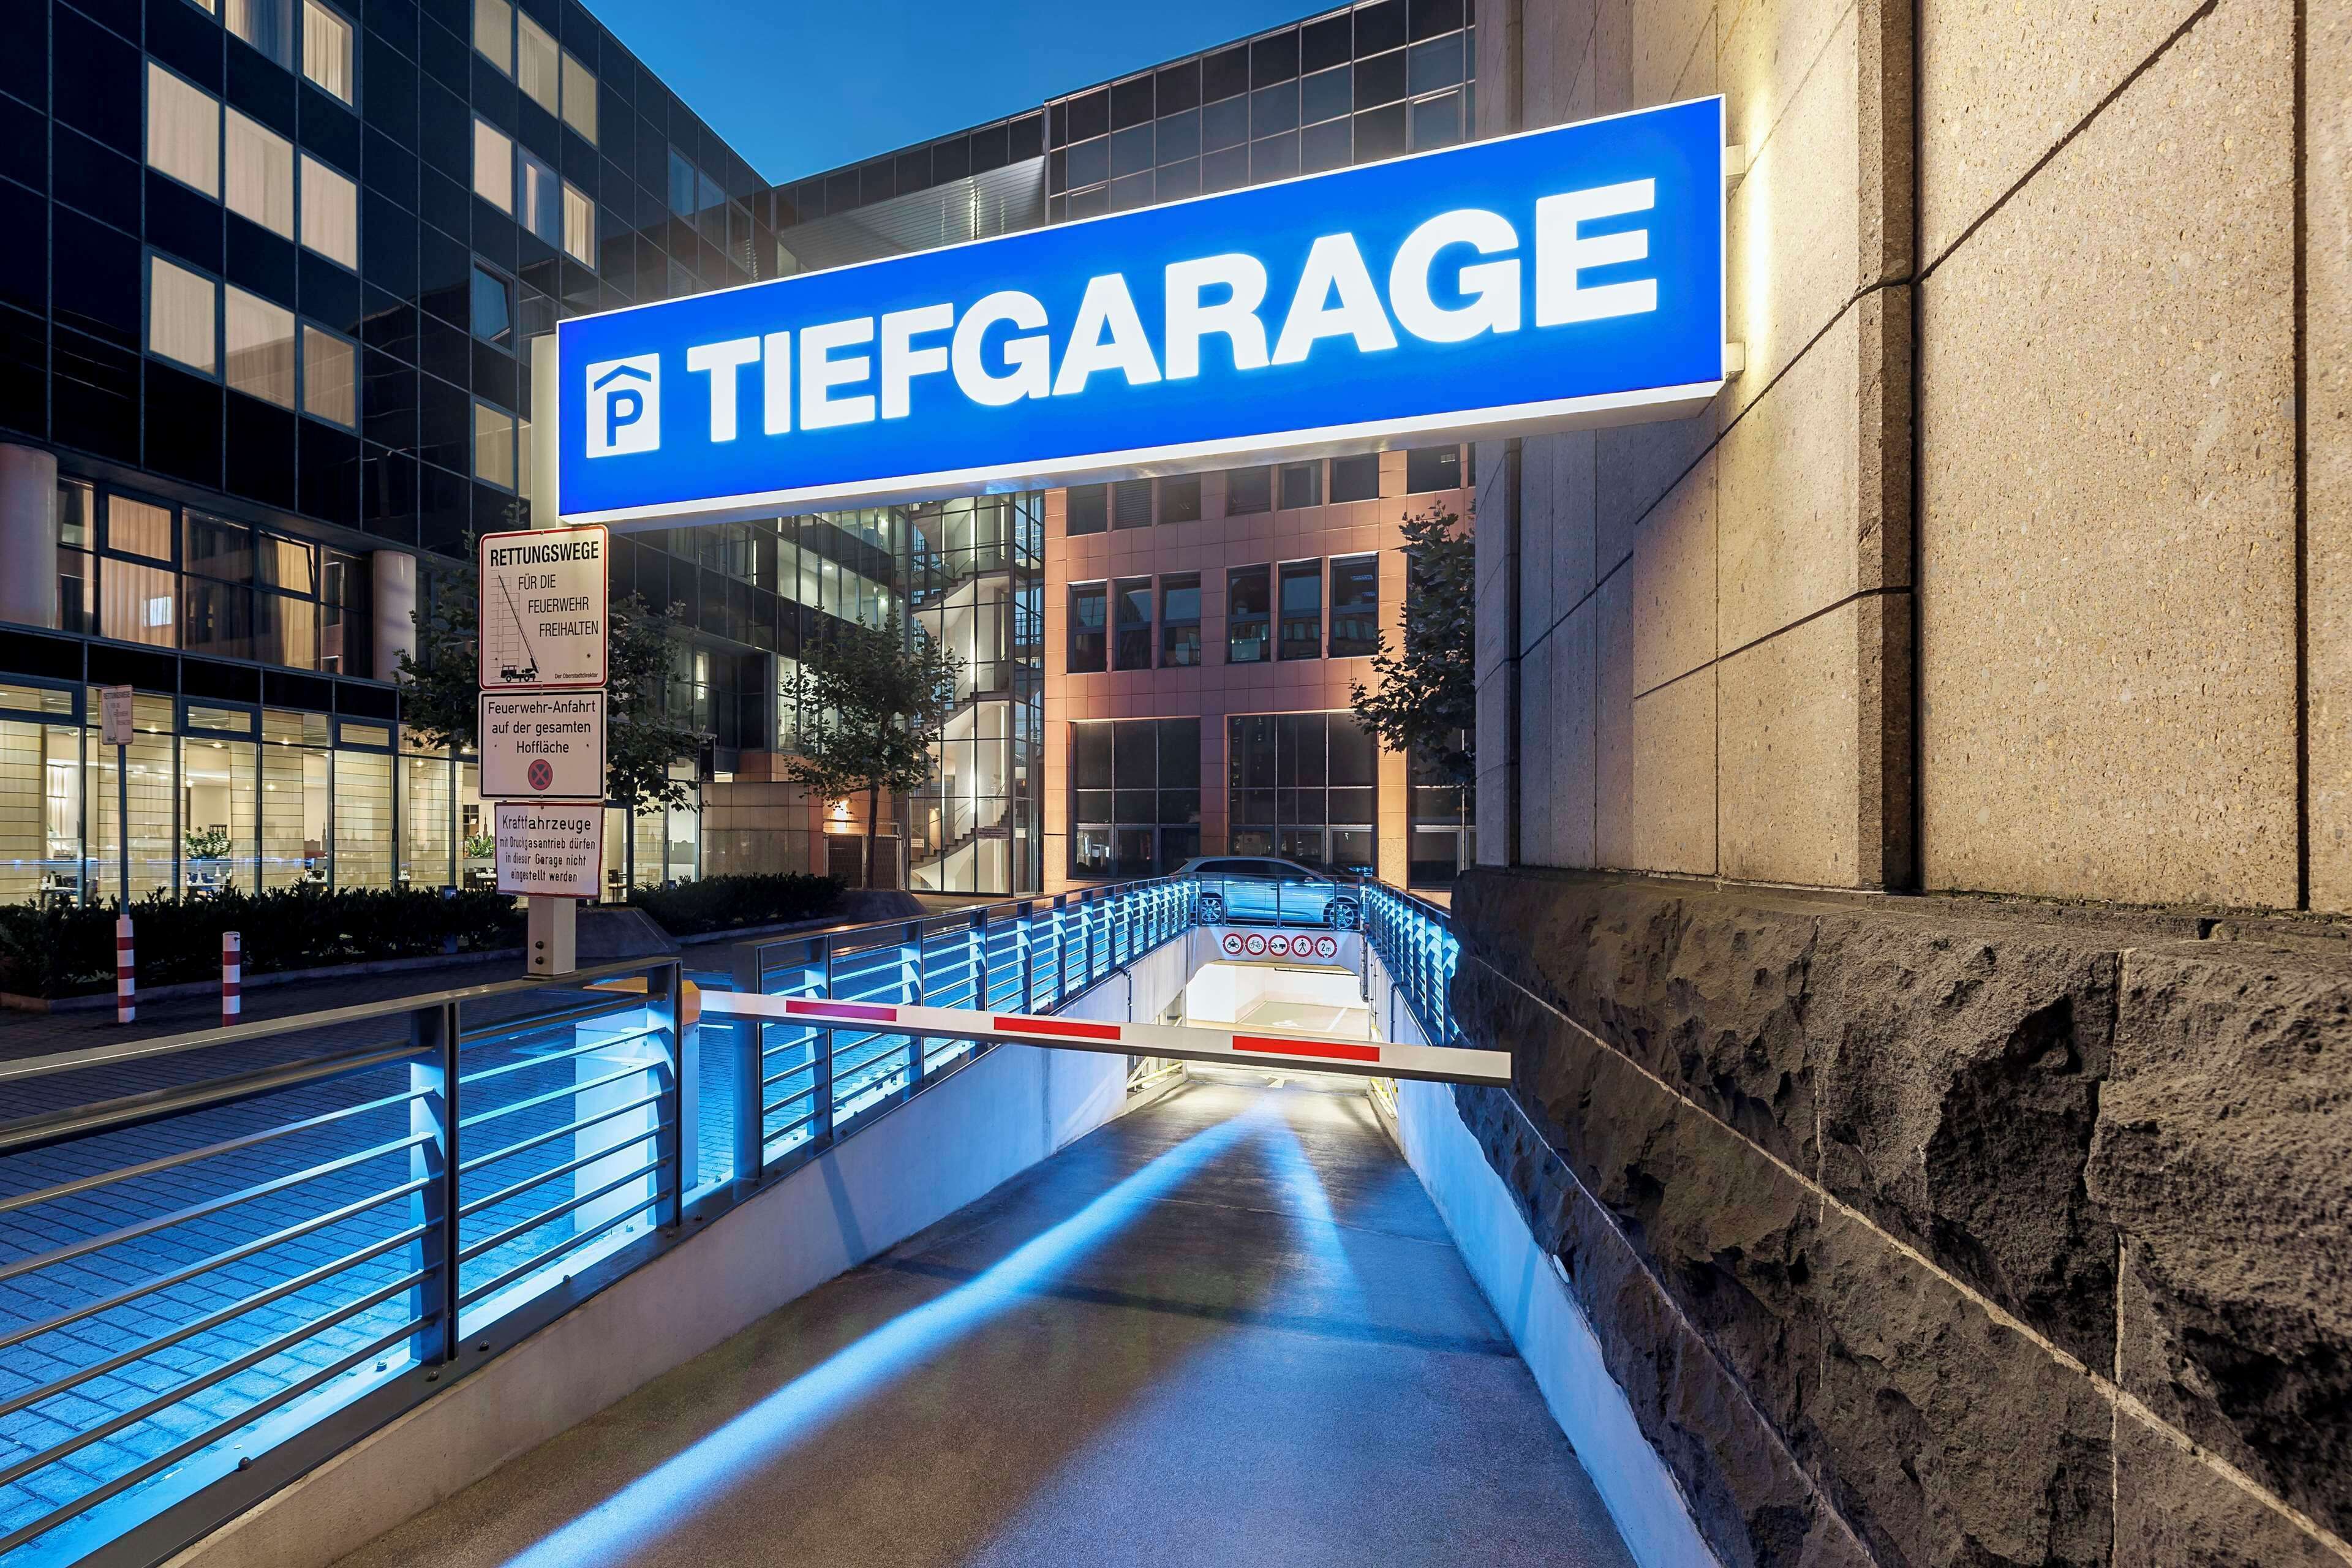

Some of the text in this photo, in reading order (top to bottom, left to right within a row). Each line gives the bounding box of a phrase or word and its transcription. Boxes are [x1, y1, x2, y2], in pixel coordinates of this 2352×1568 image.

[607, 178, 1657, 447] P TIEFGARAGE
[491, 541, 598, 567] RETTUNGSWEGE
[518, 573, 556, 590] FÜR DIE
[528, 597, 589, 614] FEUERWEHR
[539, 620, 598, 637] FREIHALTEN
[488, 700, 595, 714] Feuerwehr-Anfahrt
[492, 721, 591, 736] auf der gesamten
[516, 741, 569, 753] Hoffläche
[502, 815, 591, 834] Kraftfahrzeuge
[500, 836, 595, 851] mit Druckgasantrieb dürfen
[505, 852, 511, 863] in
[535, 853, 562, 868] Garage
[566, 854, 586, 866] nicht
[511, 868, 578, 883] eingestellt werden
